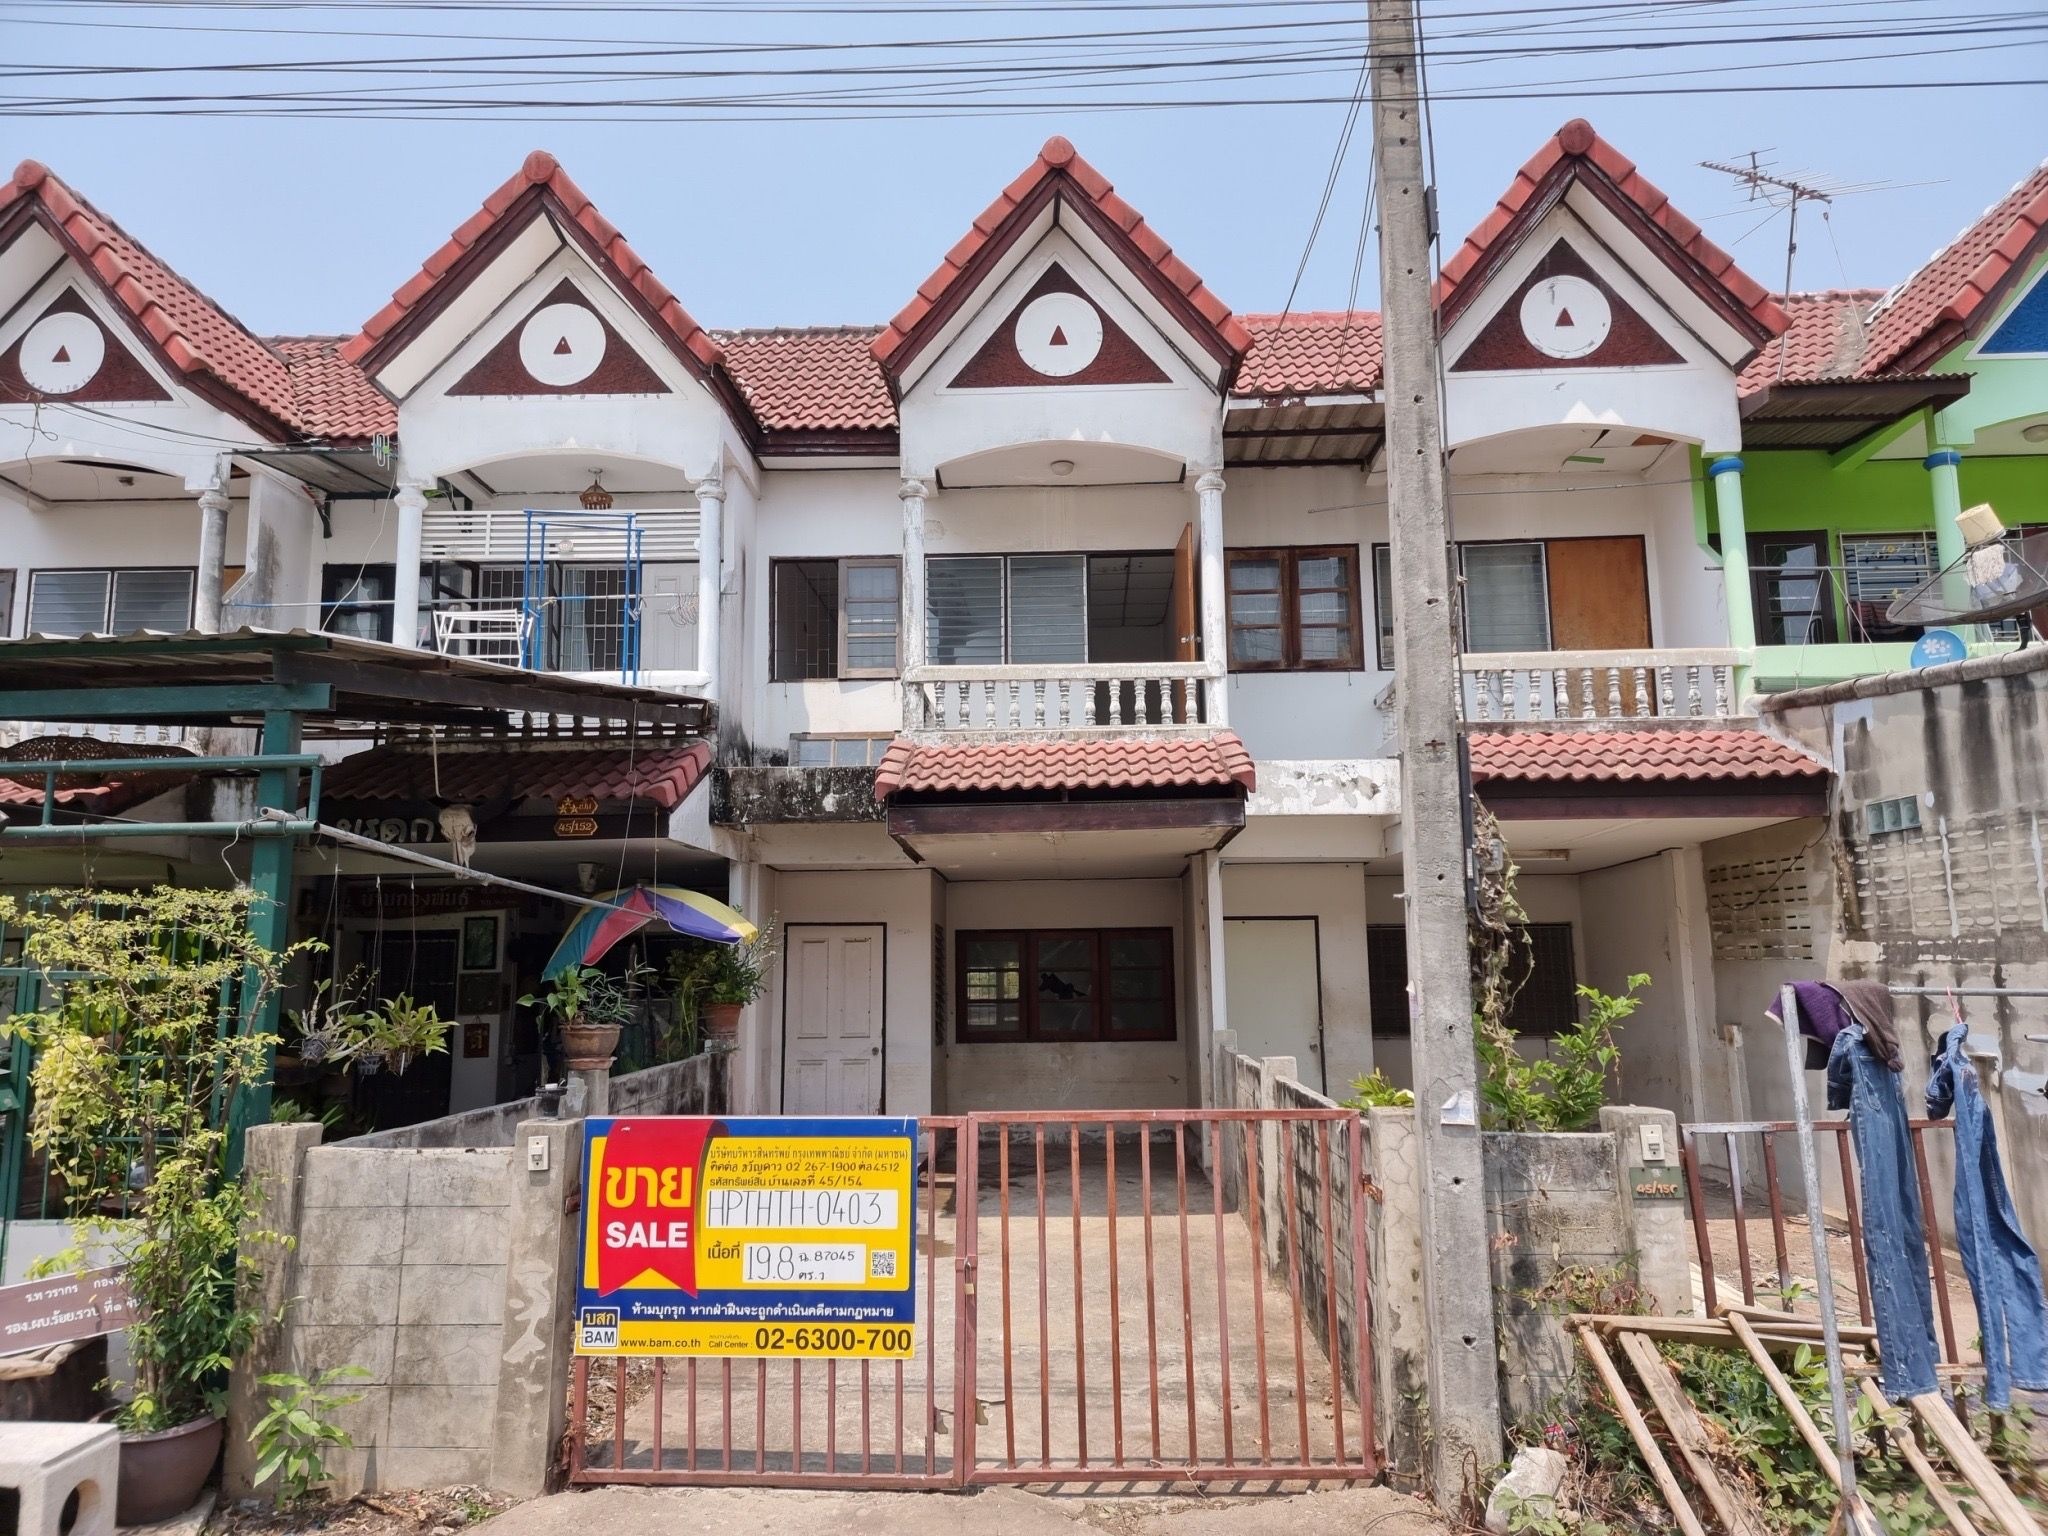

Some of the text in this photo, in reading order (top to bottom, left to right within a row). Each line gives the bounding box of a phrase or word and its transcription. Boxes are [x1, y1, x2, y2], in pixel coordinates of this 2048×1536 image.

[558, 819, 593, 832] 45/152
[792, 1145, 850, 1163] กรุงเทพพาณิชย์
[852, 1145, 872, 1159] จำกัด
[875, 1148, 908, 1160] (มหาชน)
[785, 1162, 801, 1171] 02
[805, 1162, 857, 1172] 267-1900
[605, 1166, 691, 1208] ขาย
[709, 1175, 767, 1187] รหัสทรัพย์สิน
[819, 1175, 863, 1187] 45/154
[707, 1190, 883, 1228] HPTHTH-0403
[605, 1221, 689, 1249] SALE
[707, 1240, 741, 1260] เนื้อที่
[814, 1250, 856, 1262] 87045
[747, 1245, 795, 1281] 19.8
[585, 1311, 616, 1326] บสก
[631, 1301, 895, 1321] ห้ามบุกรุก หากฝ่าฝืนจะถูกดำเนินคดีตามกฎหมาย
[584, 1330, 615, 1344] BAM
[620, 1337, 701, 1348] www.bam.co.th
[708, 1340, 723, 1348] Call
[724, 1340, 749, 1348] Center
[755, 1328, 912, 1351] 02-6300-700
